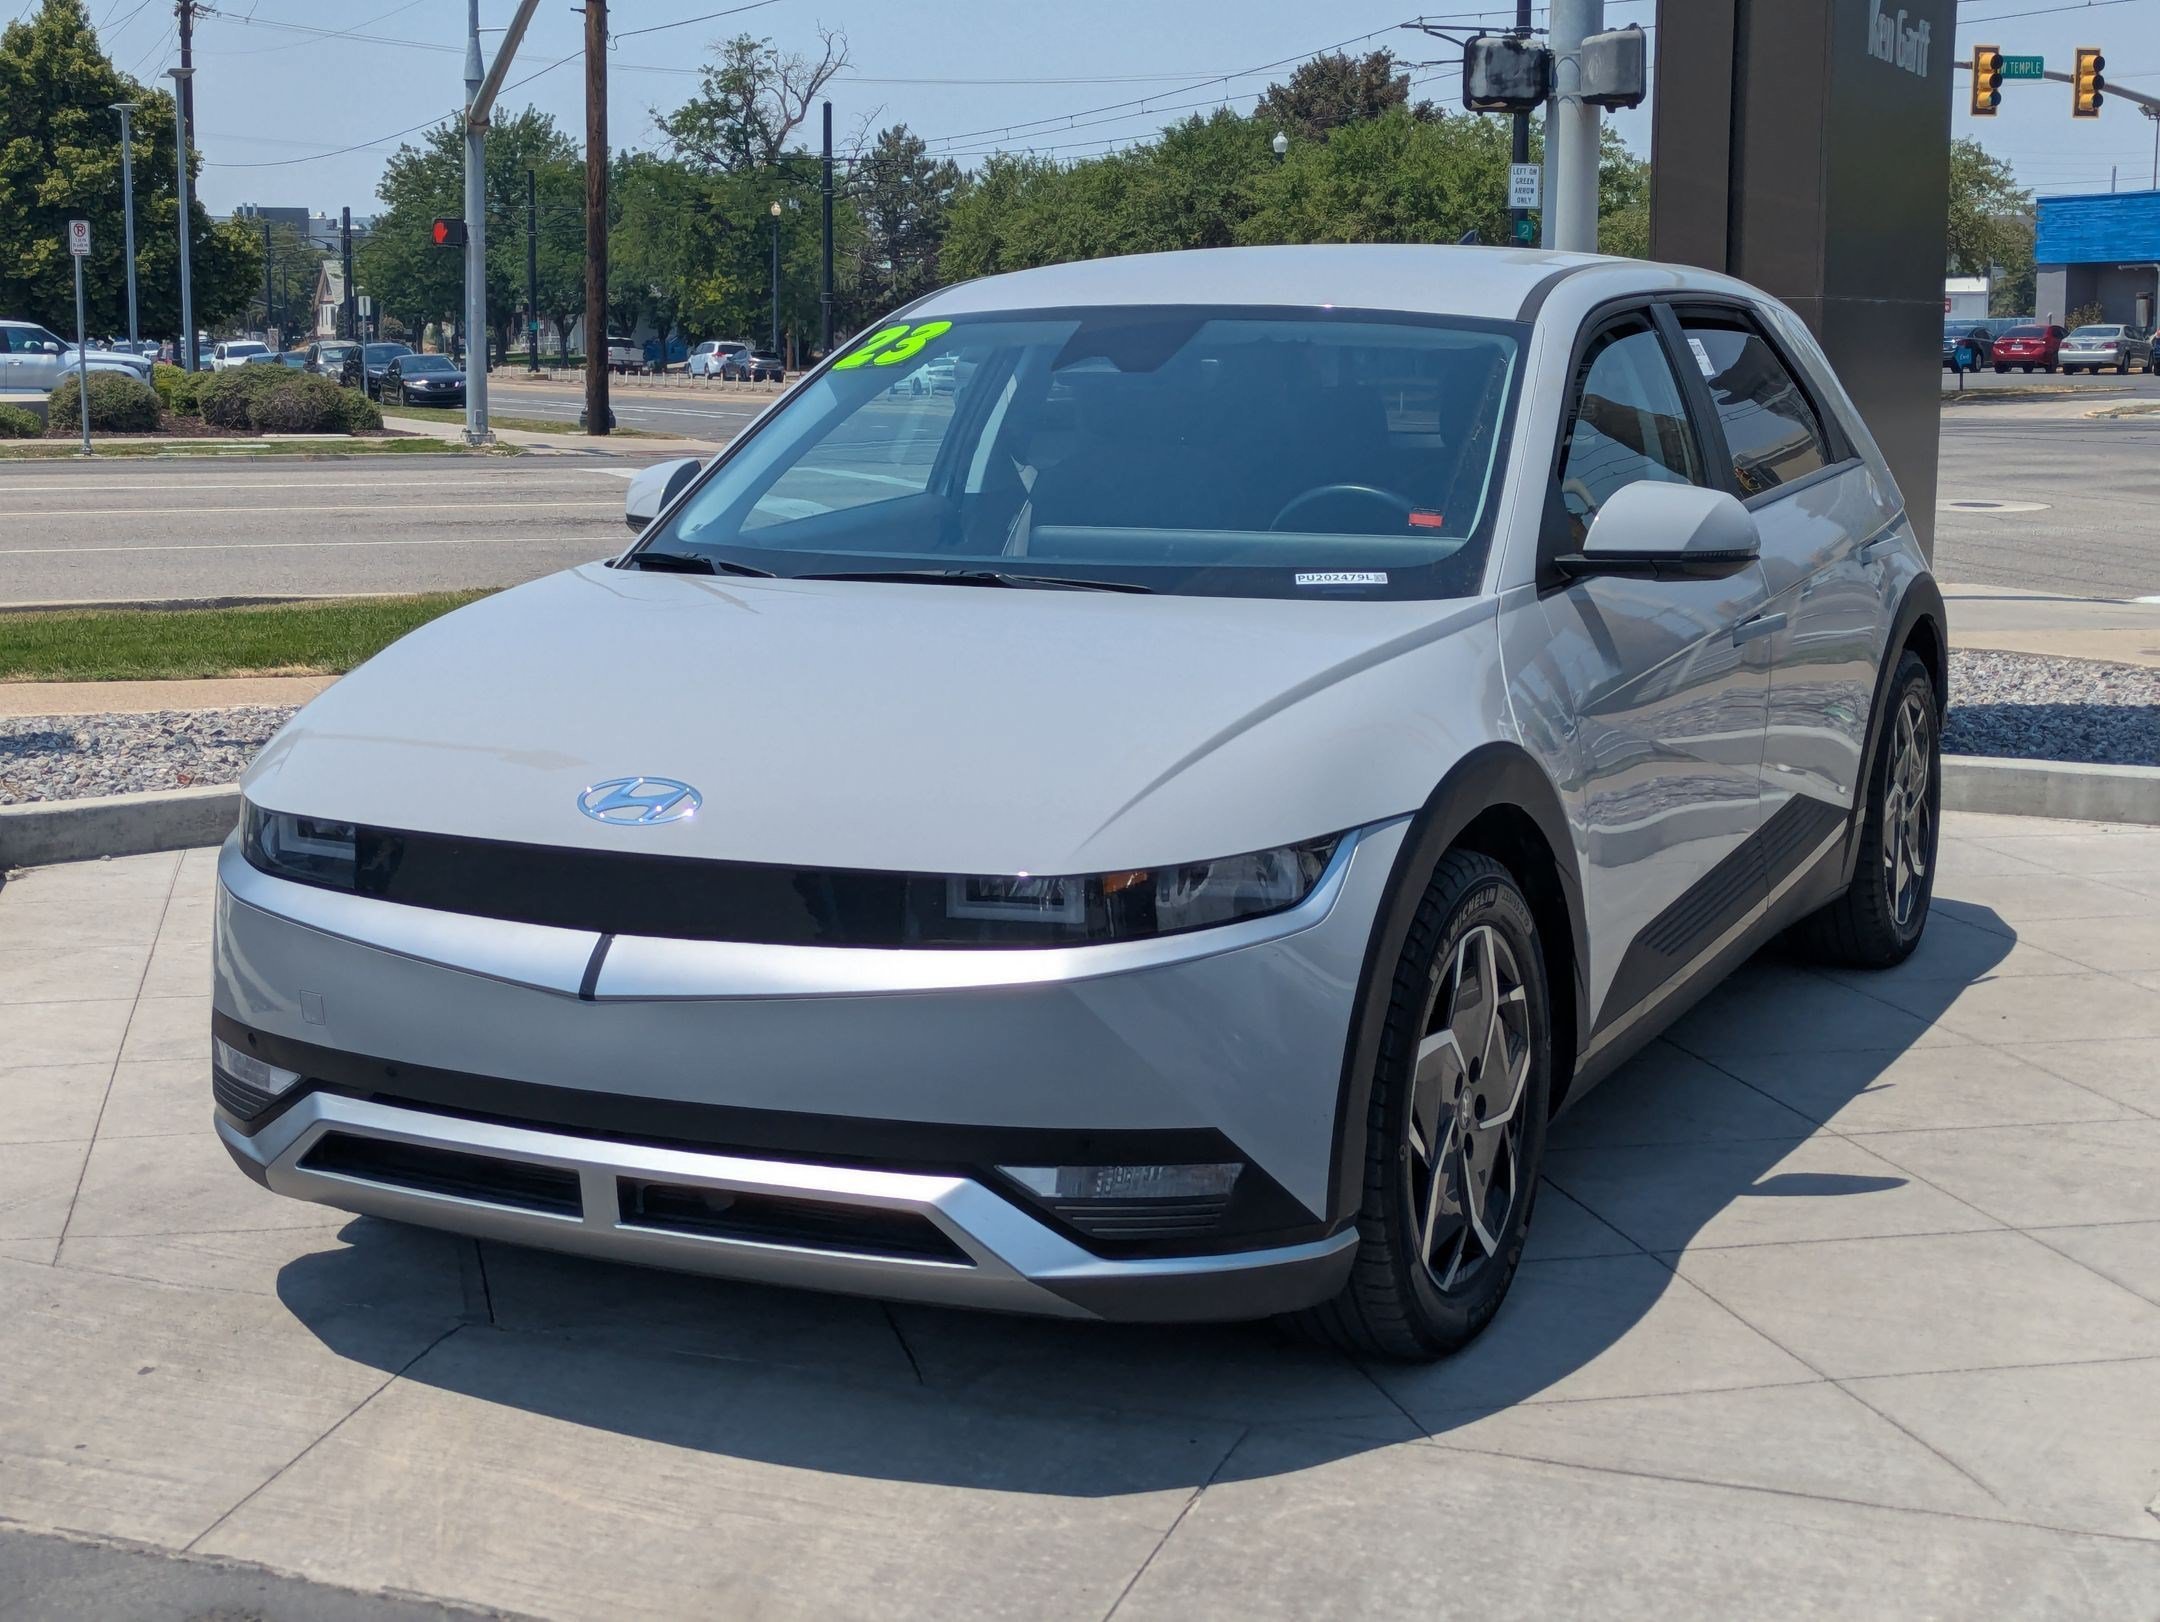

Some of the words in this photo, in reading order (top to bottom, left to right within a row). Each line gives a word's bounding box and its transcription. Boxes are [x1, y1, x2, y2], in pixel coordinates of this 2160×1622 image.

[1868, 0, 1894, 63] Ken
[1896, 9, 1931, 78] Garff
[2010, 61, 2041, 74] TEMPLE
[1513, 168, 1527, 176] LEFT
[1529, 168, 1537, 176] ON
[1515, 177, 1534, 185] GREEN
[1520, 224, 1529, 237] 2
[832, 321, 952, 370] 23
[1297, 574, 1373, 582] PU202479L
[1449, 887, 1497, 941] MICHELIN
